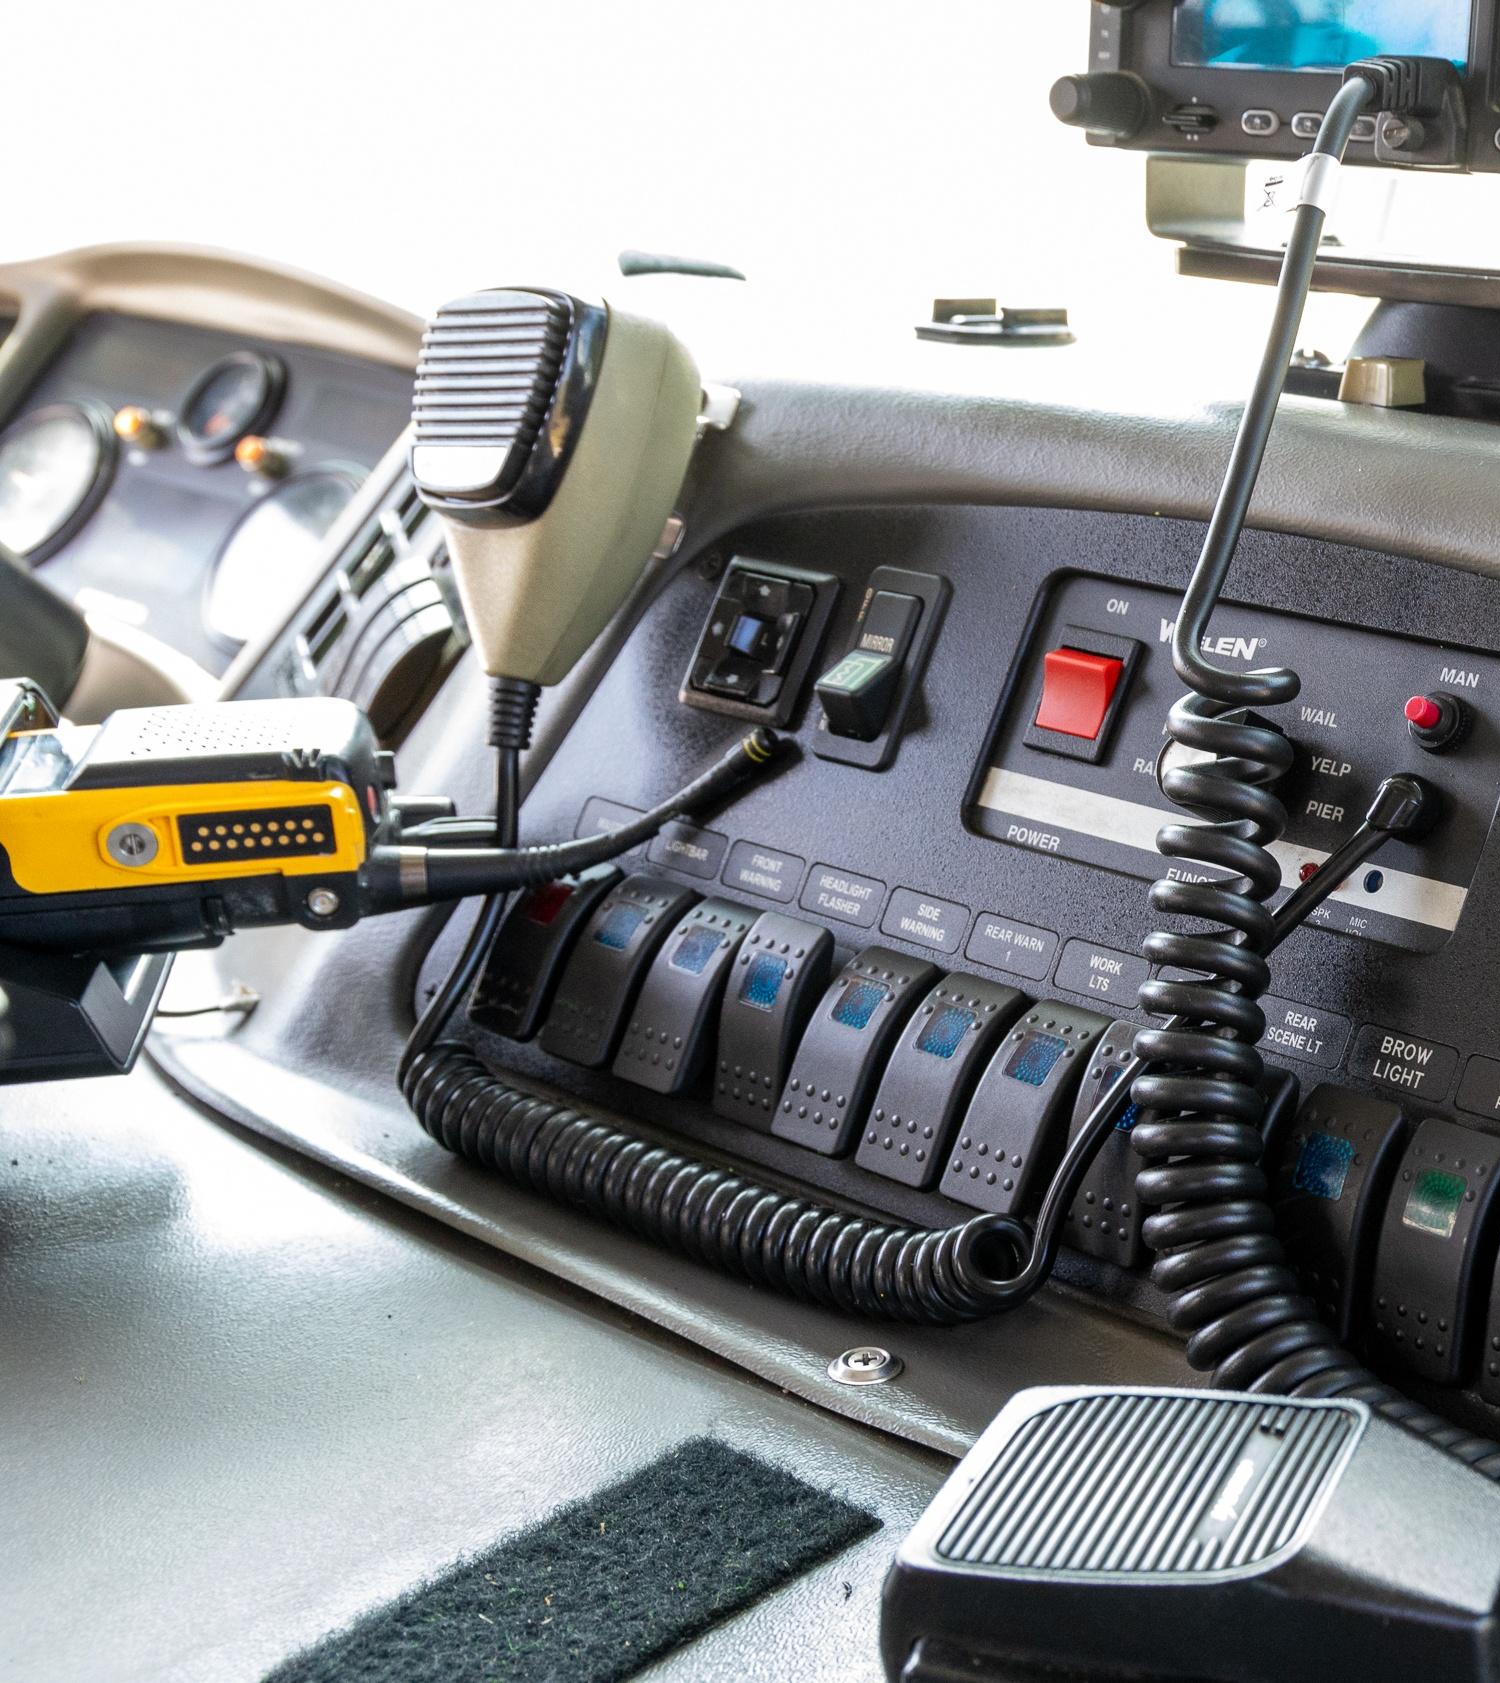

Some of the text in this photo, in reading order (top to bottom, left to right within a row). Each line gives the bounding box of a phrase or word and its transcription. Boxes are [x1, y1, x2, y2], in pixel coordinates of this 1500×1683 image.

[1106, 599, 1129, 615] ON
[860, 633, 895, 653] MIRROR
[1160, 618, 1258, 660] WLEN
[1440, 667, 1480, 688] MAN
[1301, 706, 1338, 728] WAIL
[1311, 756, 1352, 777] YELP
[1306, 800, 1345, 822] PIER
[1006, 825, 1061, 852] POWER
[751, 854, 783, 872] FRONT
[740, 871, 782, 892] WARNING
[819, 874, 872, 900] HEADLIGHT
[818, 893, 861, 916] FLASHER
[917, 904, 941, 921] SIDE
[1311, 907, 1331, 919] SPK
[900, 917, 945, 942] WARNING
[1349, 917, 1367, 929] MIC
[985, 924, 1045, 952] REAR WARN
[1090, 954, 1124, 975] WORK
[1089, 975, 1110, 992] LTS
[1285, 1011, 1317, 1032] REAR
[1267, 1027, 1322, 1055] SCENE LT
[1381, 1036, 1433, 1066] BROW
[1372, 1059, 1425, 1089] LIGHT
